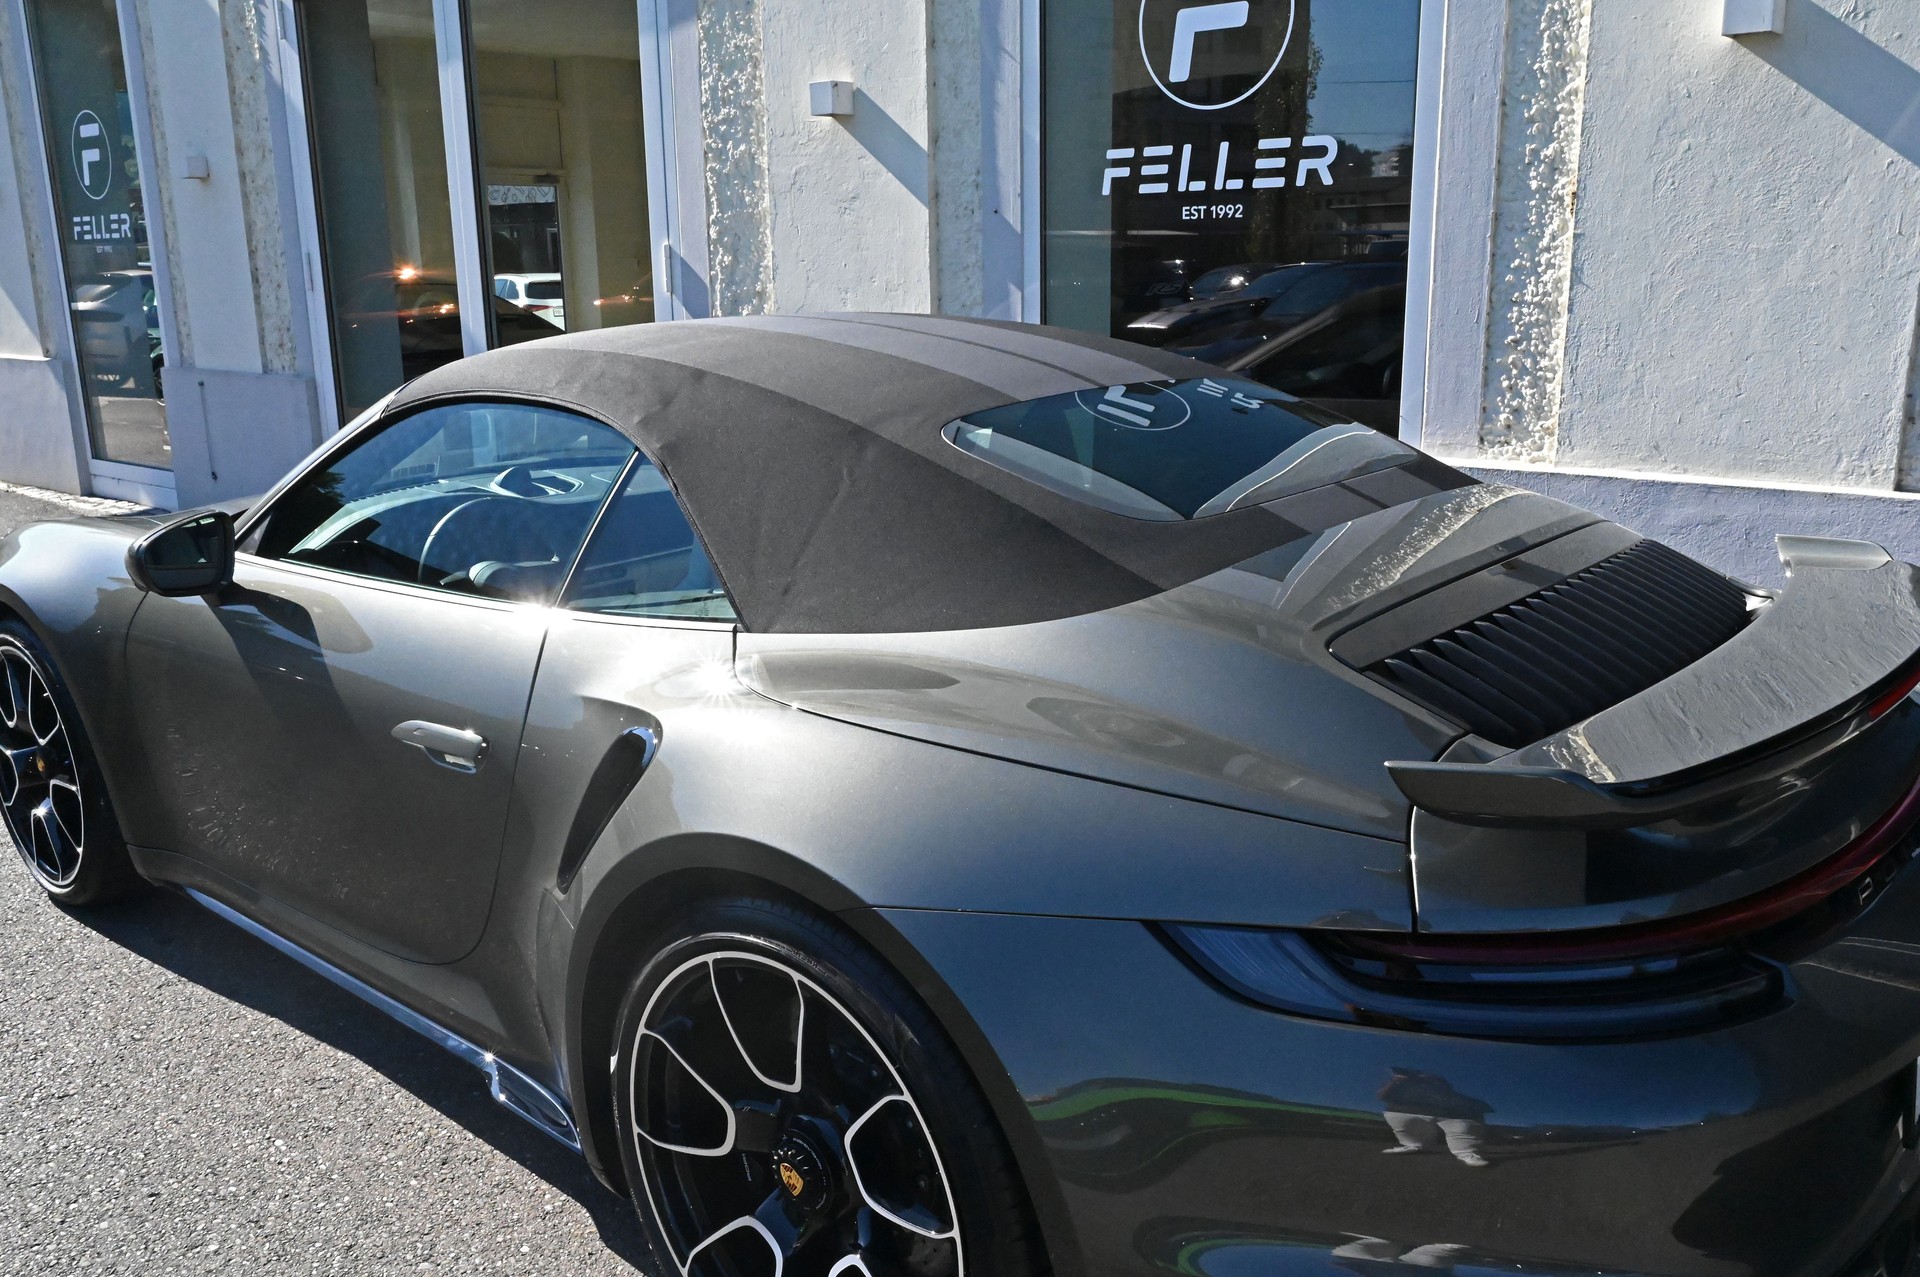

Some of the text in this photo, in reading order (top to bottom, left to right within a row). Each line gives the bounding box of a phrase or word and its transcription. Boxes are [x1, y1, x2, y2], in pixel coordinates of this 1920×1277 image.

[79, 123, 100, 186] F
[1101, 134, 1339, 196] FELLER
[73, 213, 131, 240] FELLER
[1182, 204, 1243, 220] EST 1992
